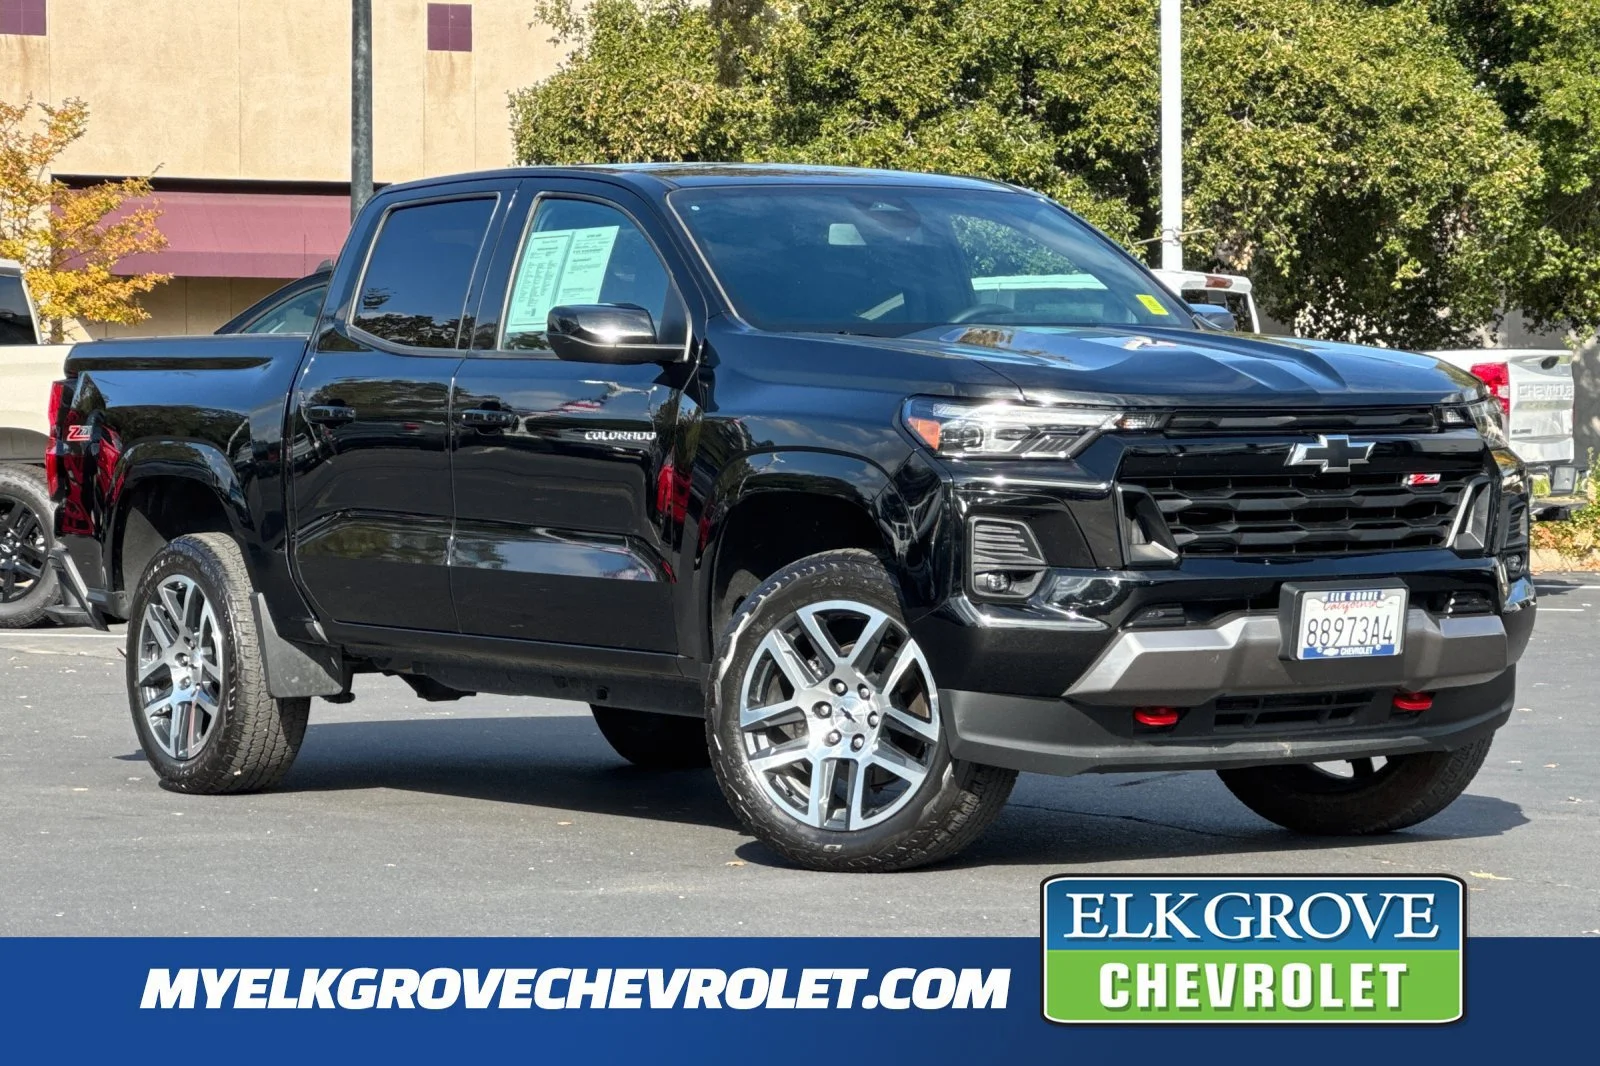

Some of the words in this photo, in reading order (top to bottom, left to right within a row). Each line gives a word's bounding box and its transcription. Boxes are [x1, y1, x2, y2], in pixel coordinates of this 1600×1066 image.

[585, 431, 657, 441] COLORADO
[1330, 593, 1346, 602] ELK
[1349, 591, 1378, 601] GROVE
[1307, 615, 1392, 647] 88973A4
[1340, 647, 1373, 656] CHEVROLET
